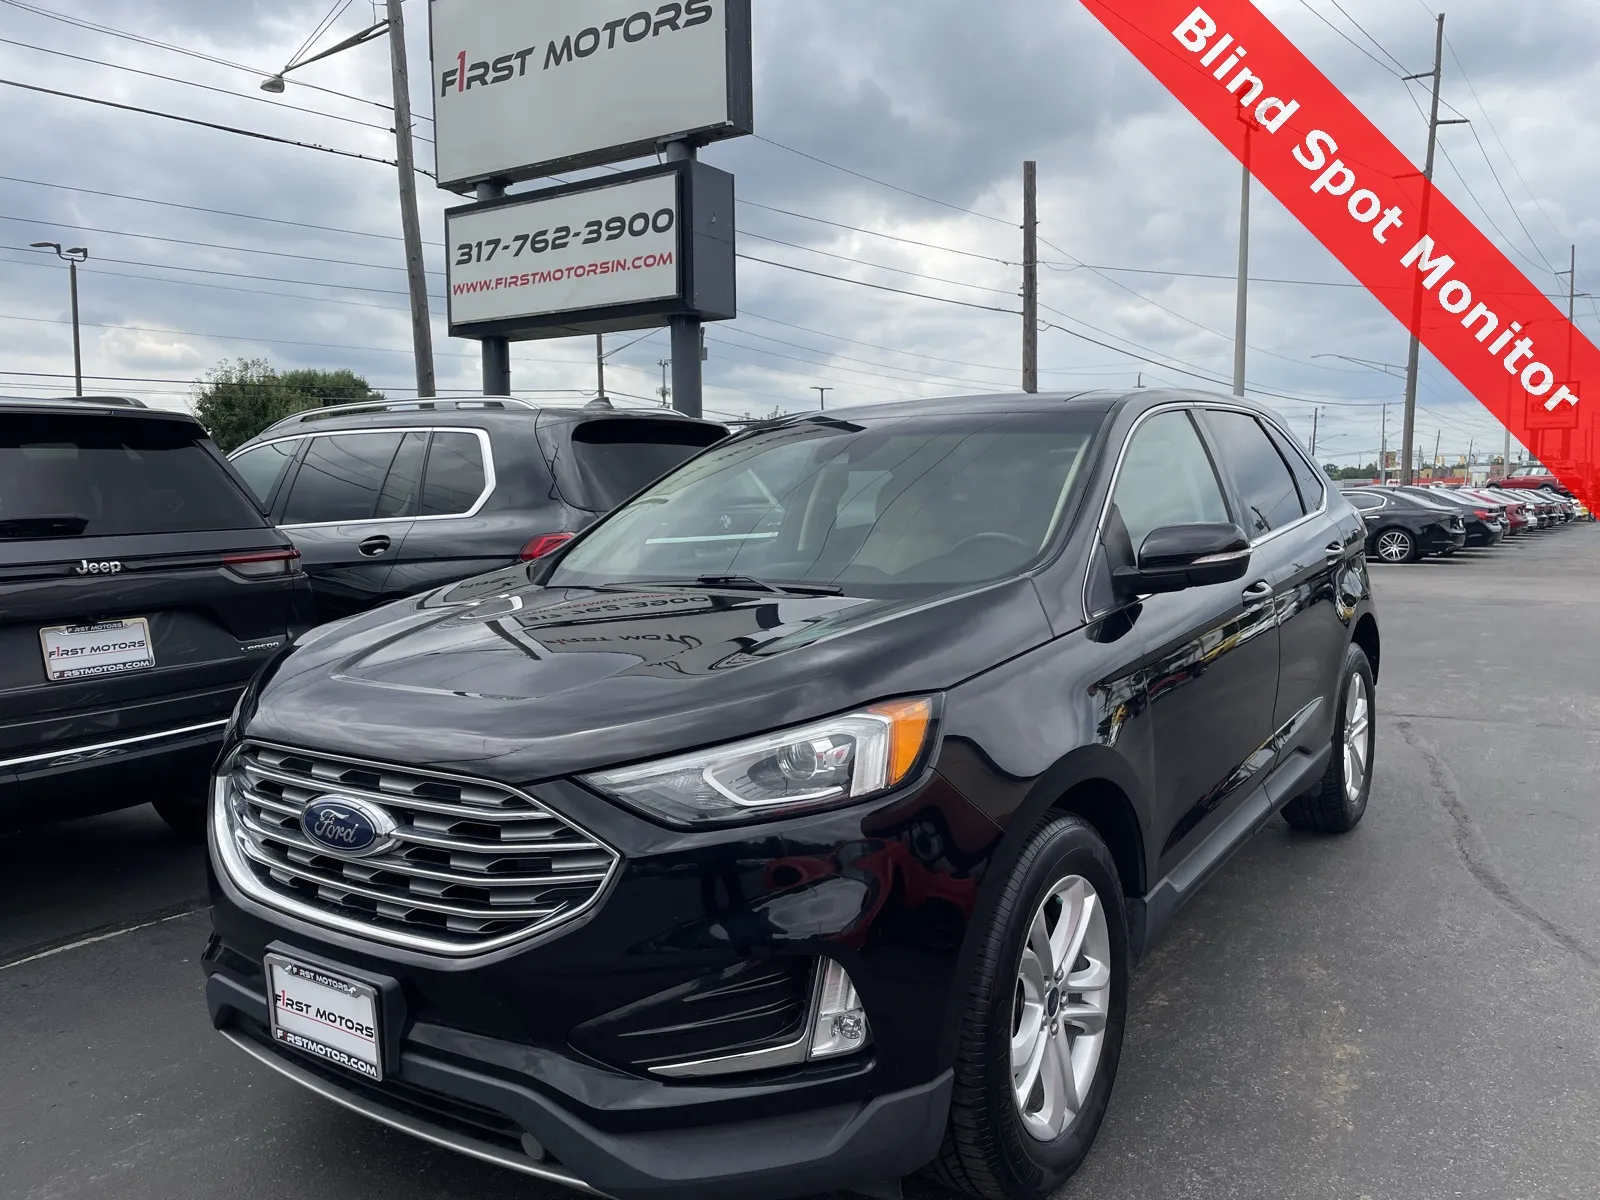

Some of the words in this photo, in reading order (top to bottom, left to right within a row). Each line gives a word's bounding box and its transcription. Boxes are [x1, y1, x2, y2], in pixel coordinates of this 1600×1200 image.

[543, 0, 713, 71] MOTORS
[455, 208, 674, 266] 317-762-3900
[453, 252, 673, 295] WWW.FIRSTMOTORSIN.COM
[76, 559, 121, 575] Jeep
[91, 622, 122, 631] MOTORS
[90, 640, 146, 653] MOTORS
[314, 808, 359, 843] Ford
[315, 974, 349, 991] MOTORS
[315, 1008, 374, 1038] MOTORS
